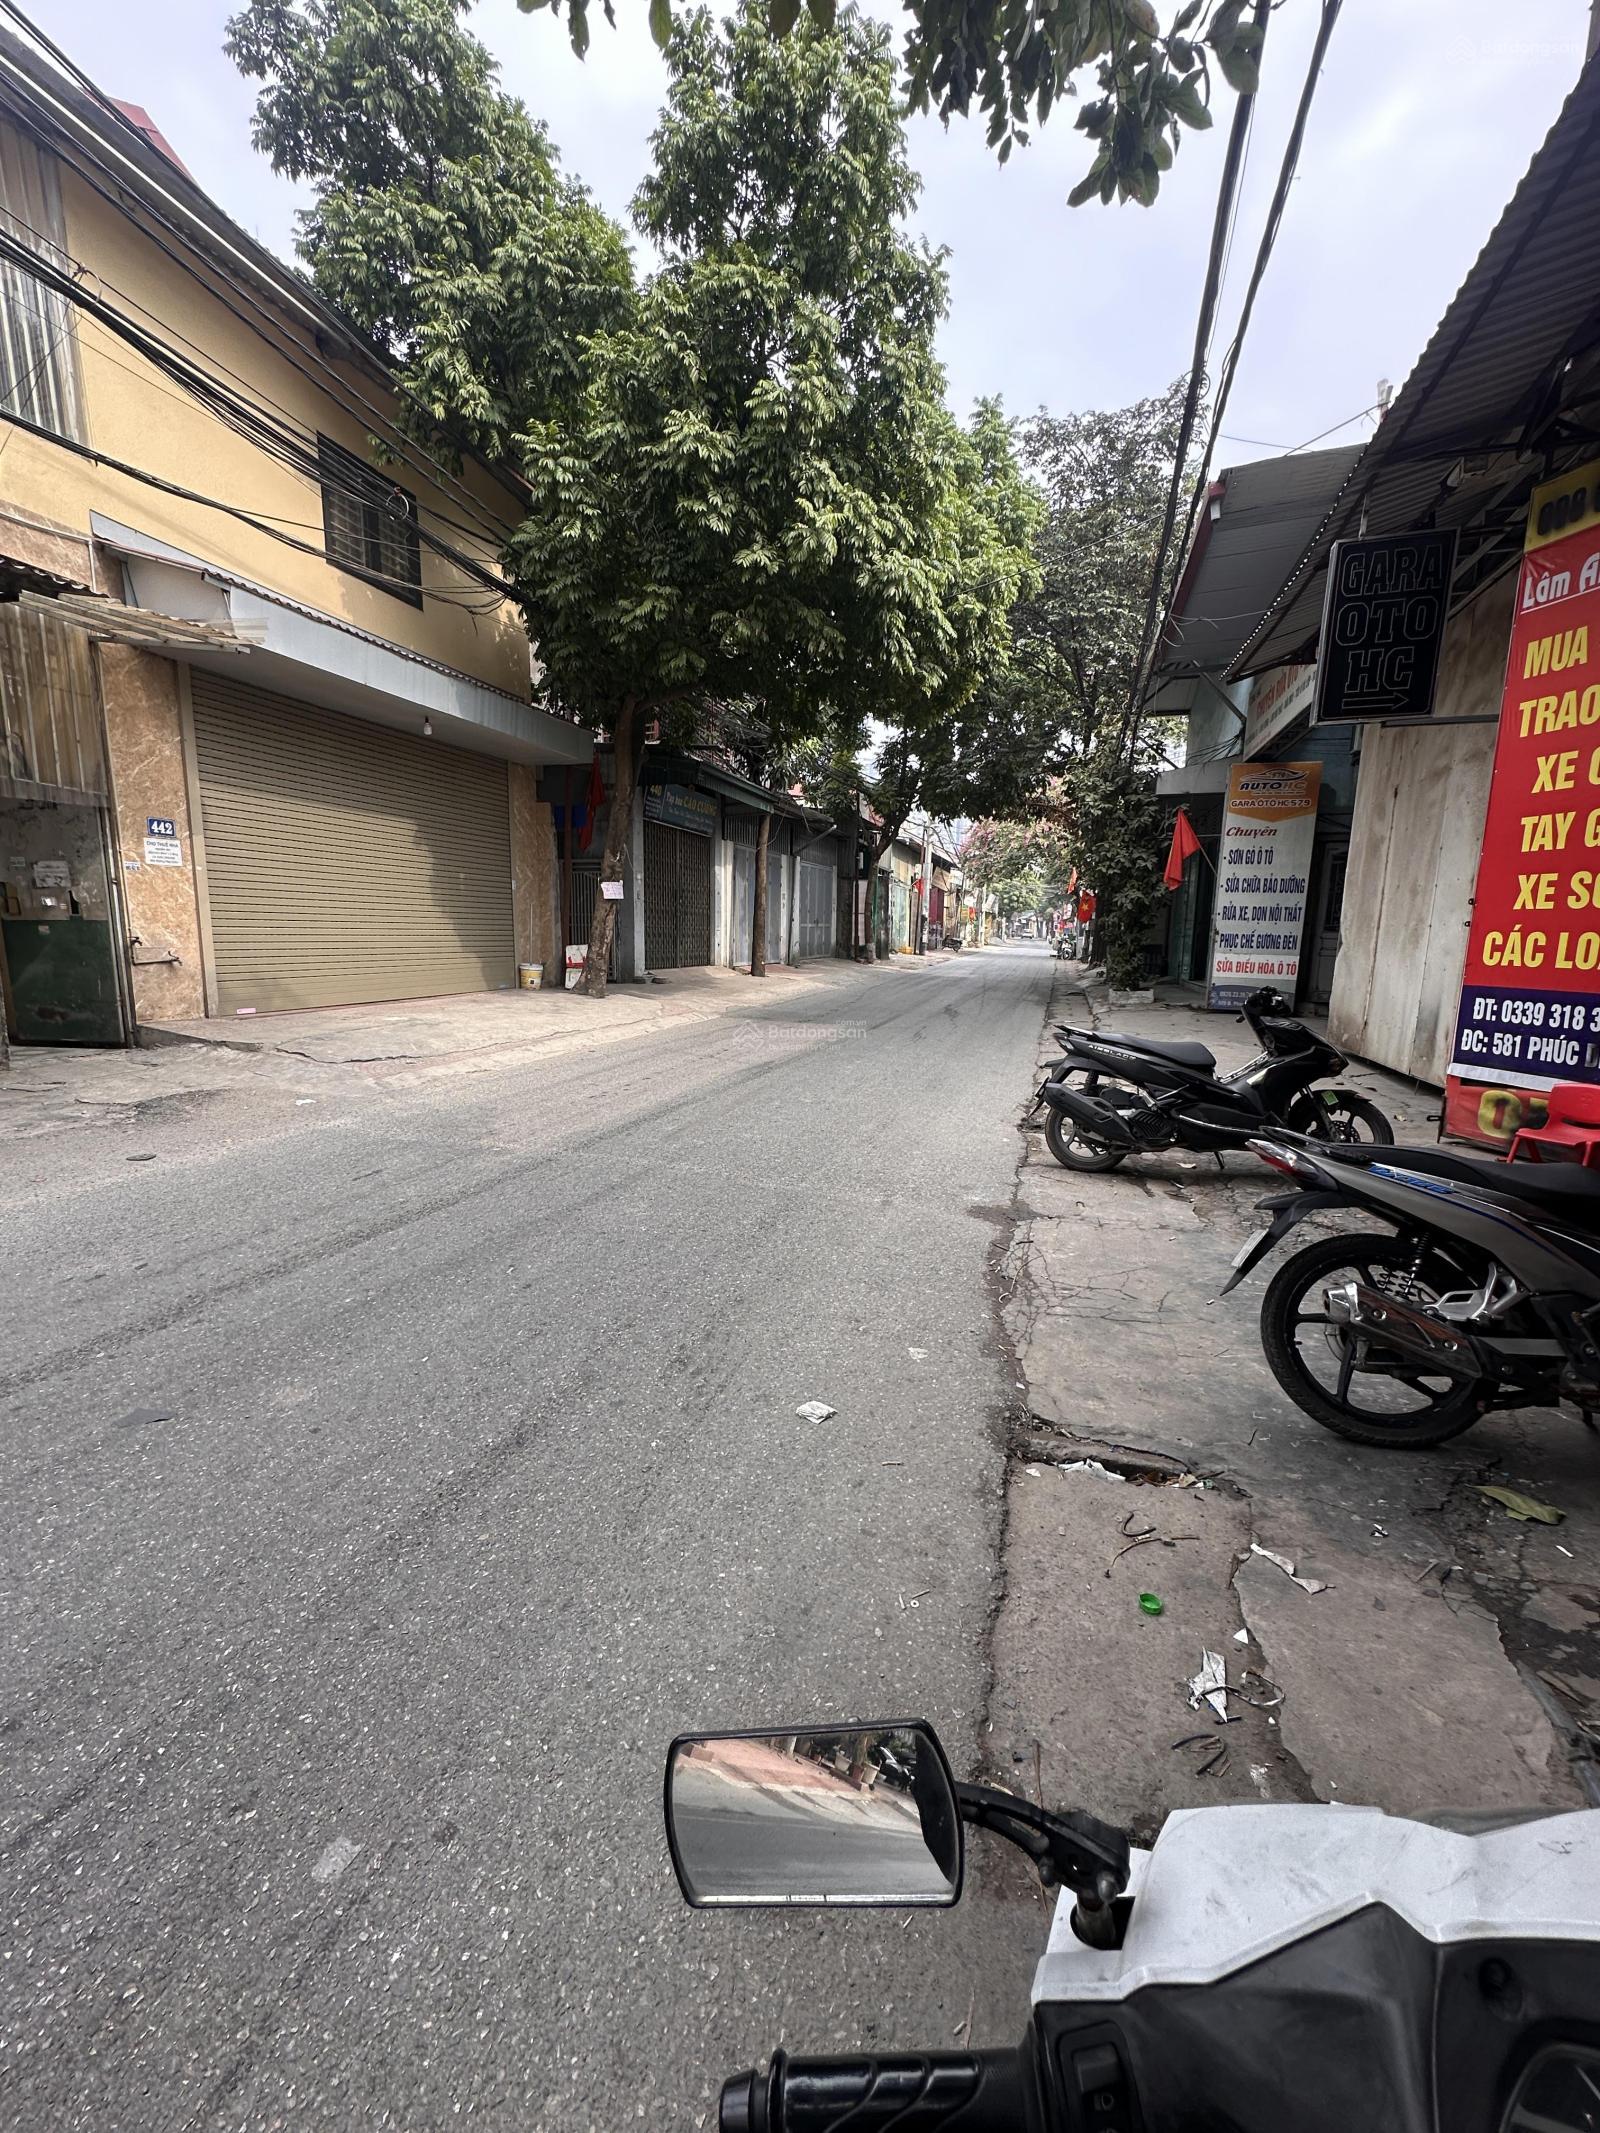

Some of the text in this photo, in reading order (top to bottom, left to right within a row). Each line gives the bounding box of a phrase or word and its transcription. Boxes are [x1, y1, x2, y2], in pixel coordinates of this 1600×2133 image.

[1341, 544, 1443, 597] GARA
[1522, 551, 1600, 609] Lâm A
[1335, 596, 1439, 646] OTO
[1344, 646, 1416, 693] HC
[1523, 625, 1588, 680] MUA
[1519, 684, 1600, 738] TRAO
[1530, 750, 1579, 794] XE
[1231, 800, 1256, 808] GARA
[151, 820, 173, 835] 442
[1226, 826, 1278, 839] Chuyên
[1520, 811, 1577, 853] TAY
[1228, 847, 1244, 865] SƠN
[1257, 845, 1263, 865] Ô
[1264, 845, 1274, 865] TÔ
[1225, 872, 1306, 894] SỬA CHỮA BẢO DƯỠNG
[1512, 873, 1559, 910] XE
[1222, 900, 1237, 921] RỬA
[1251, 906, 1268, 925] DỌN
[1268, 903, 1282, 925] NỘI
[1283, 901, 1303, 922] THẤT
[1219, 929, 1298, 951] PHỤC CHẾ GƯƠNG ĐÈN
[1482, 924, 1600, 971] CÁC LO
[1216, 957, 1233, 973] SỬA
[1277, 960, 1284, 976] Ô
[1286, 960, 1297, 976] TÔ
[1472, 997, 1498, 1021] ĐT:
[1501, 999, 1545, 1026] 0339
[1548, 1003, 1586, 1031] 318
[1461, 1028, 1600, 1070] ĐC: 581 PHÚC D
